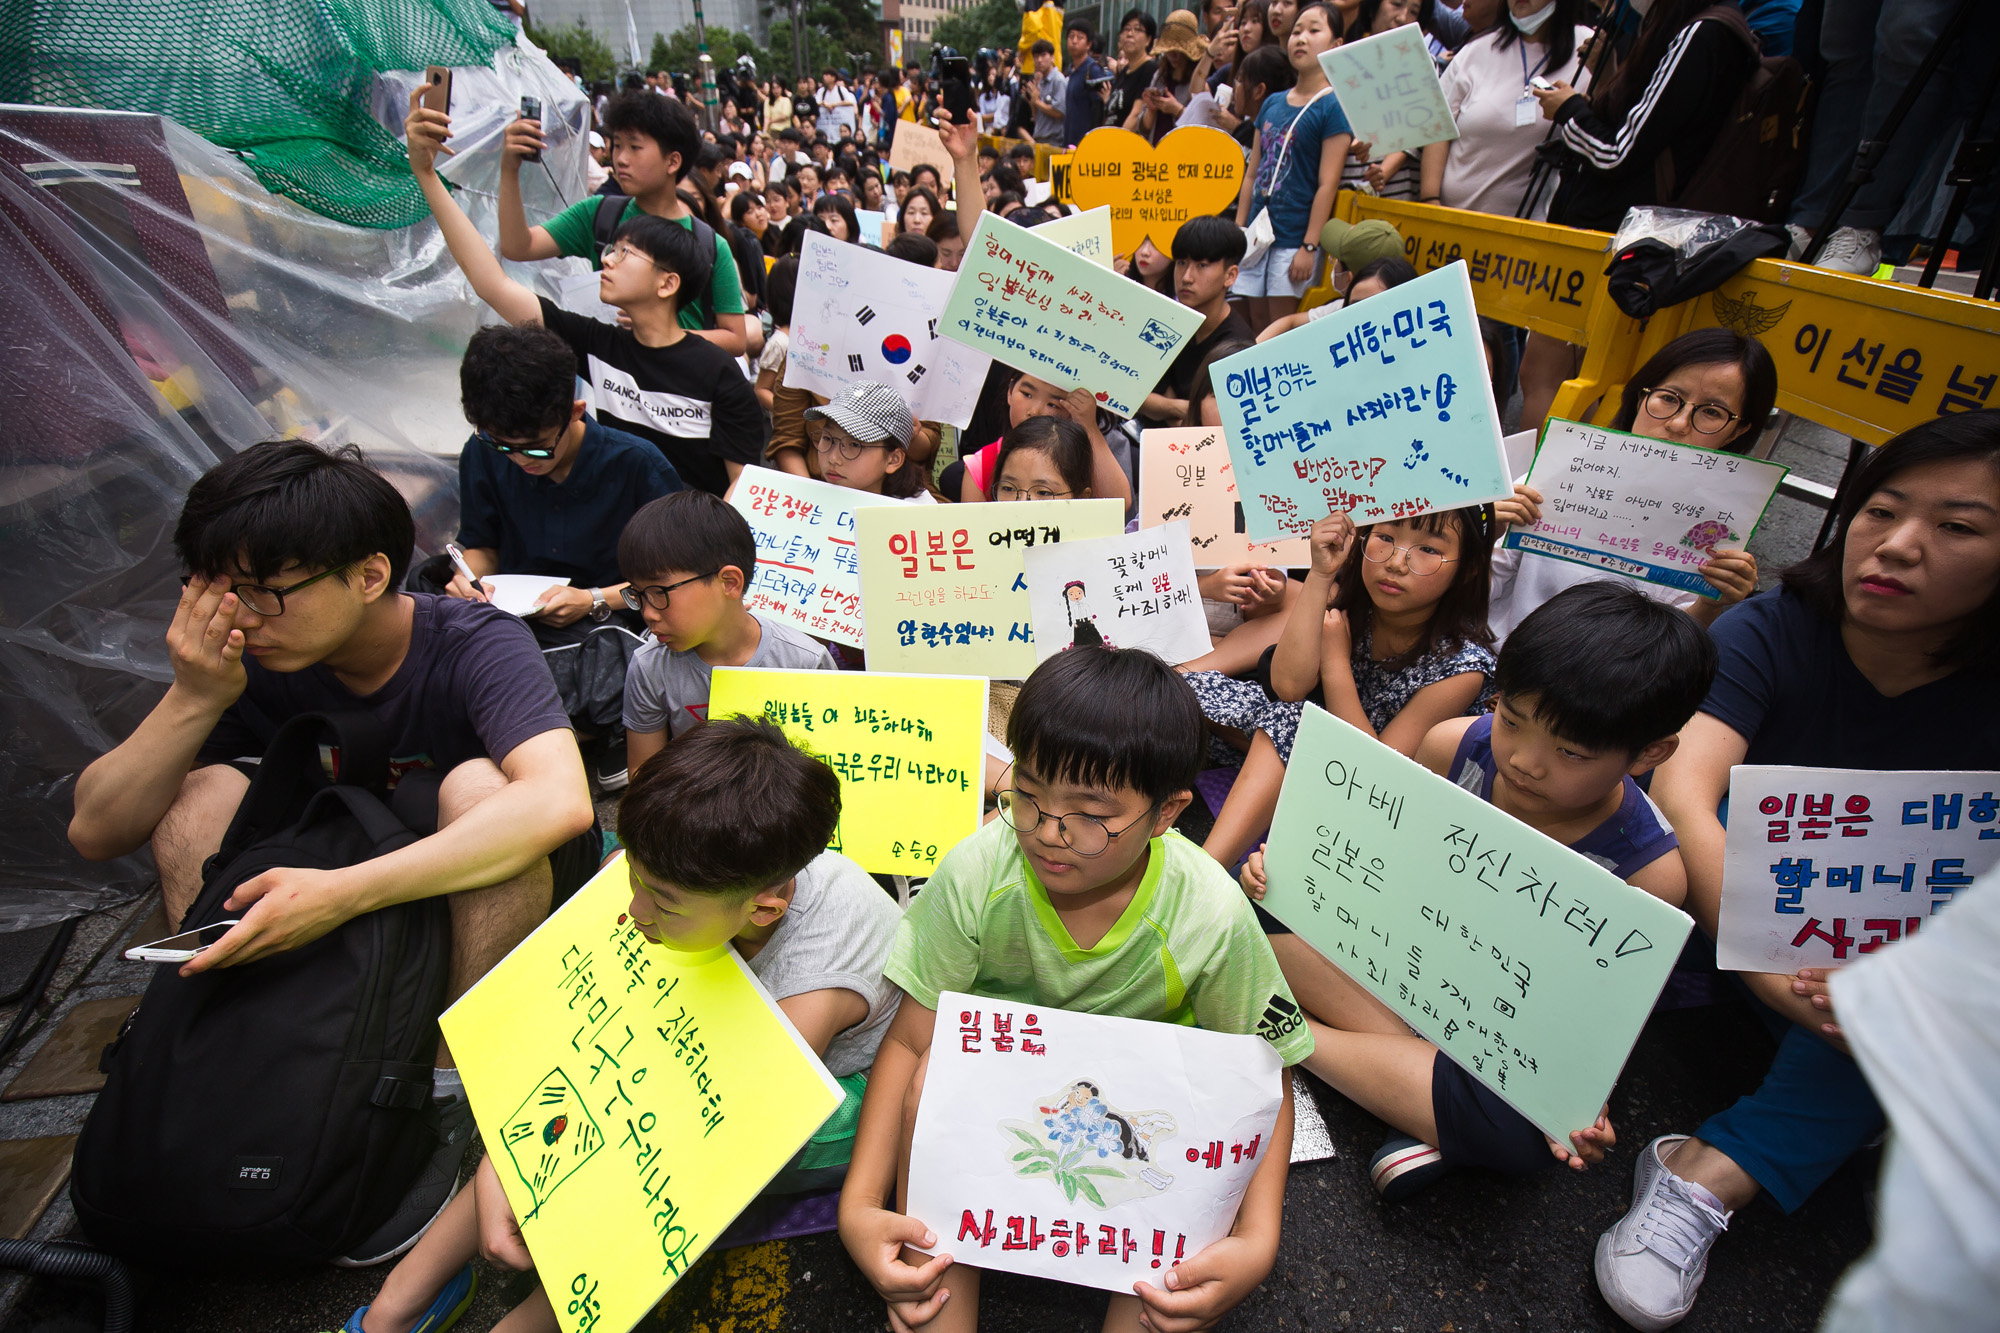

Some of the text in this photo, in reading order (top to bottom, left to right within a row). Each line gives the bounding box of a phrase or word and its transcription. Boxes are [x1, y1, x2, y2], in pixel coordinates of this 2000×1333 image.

[1078, 161, 1234, 182] 나비의 광복은 언제 오나요
[1131, 188, 1173, 204] 소녀상은
[1139, 207, 1188, 222] 역사입니다
[1066, 235, 1100, 256] 한민국
[1405, 236, 1421, 265] 이
[1470, 249, 1585, 307] 넘지마시오
[1329, 300, 1452, 368] 대한민국
[1795, 324, 1832, 373] 이
[1837, 338, 1923, 404] 선을
[603, 378, 641, 404] BIANCA
[644, 400, 704, 420] CHANDON
[1240, 420, 1332, 467] 할머니들께
[1619, 440, 1679, 463] 세상에는
[1691, 453, 1718, 470] 그런
[1725, 460, 1740, 473] 일
[1176, 464, 1206, 488] 일본
[749, 485, 823, 525] 일본정부는
[1560, 481, 1574, 493] 내
[1671, 501, 1706, 519] 일생을
[1717, 511, 1735, 523] 다
[748, 522, 820, 563] 머니들께
[888, 529, 976, 578] 일본은
[1597, 532, 1641, 552] 수요일을
[953, 584, 993, 602] 하고도
[1113, 572, 1172, 601] 들께 일본
[1325, 760, 1404, 829] 아베
[1759, 793, 1874, 843] 일본은
[1311, 824, 1532, 999] 일본은 대한민국
[653, 977, 679, 1009] 아
[959, 1010, 1047, 1055] 일본은
[657, 1006, 724, 1138] 죄송하다해
[1186, 1134, 1262, 1169] 에게
[240, 1171, 270, 1179] RED
